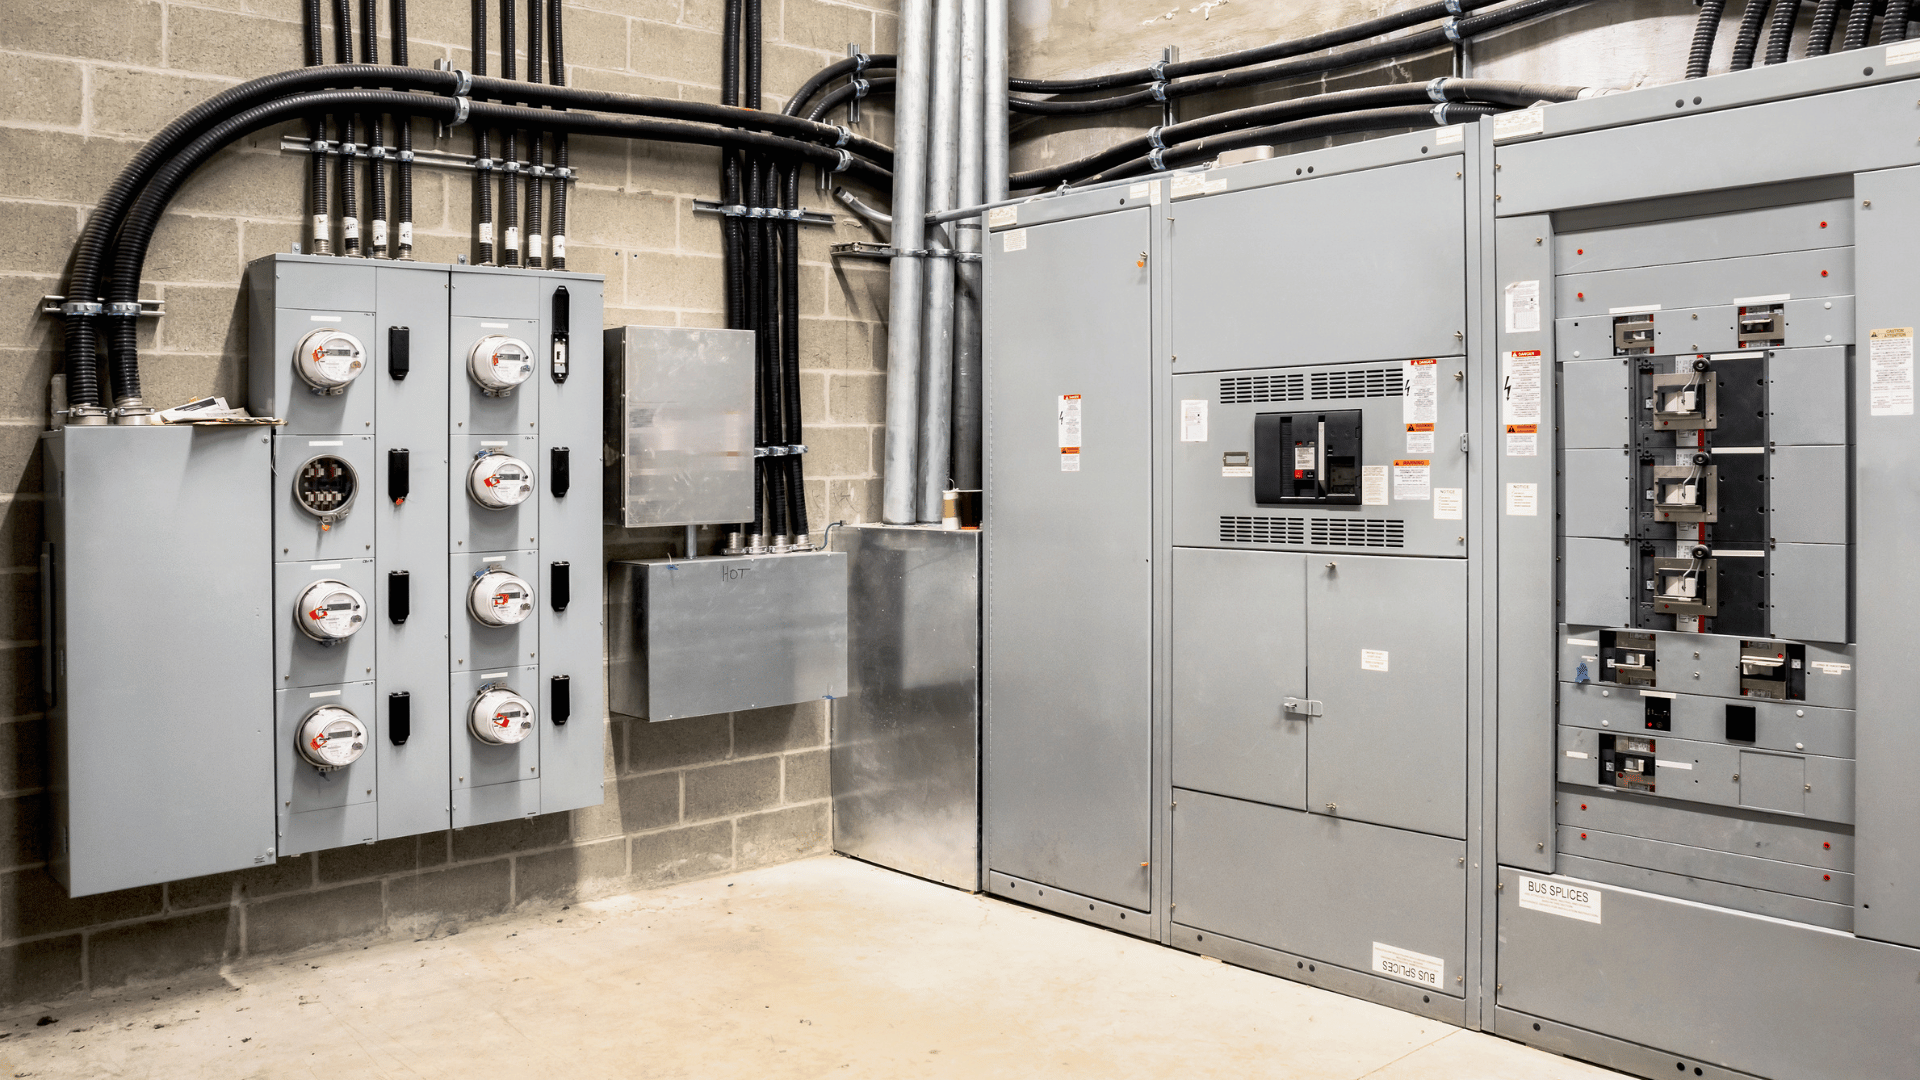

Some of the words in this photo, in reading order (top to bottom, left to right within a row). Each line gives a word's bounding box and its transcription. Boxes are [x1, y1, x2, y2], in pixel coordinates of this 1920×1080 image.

[722, 565, 750, 582] HOT
[1528, 880, 1547, 894] BUS
[1549, 885, 1589, 903] SPLICES
[1382, 960, 1416, 978] SPLICES
[1418, 970, 1435, 984] BUS
